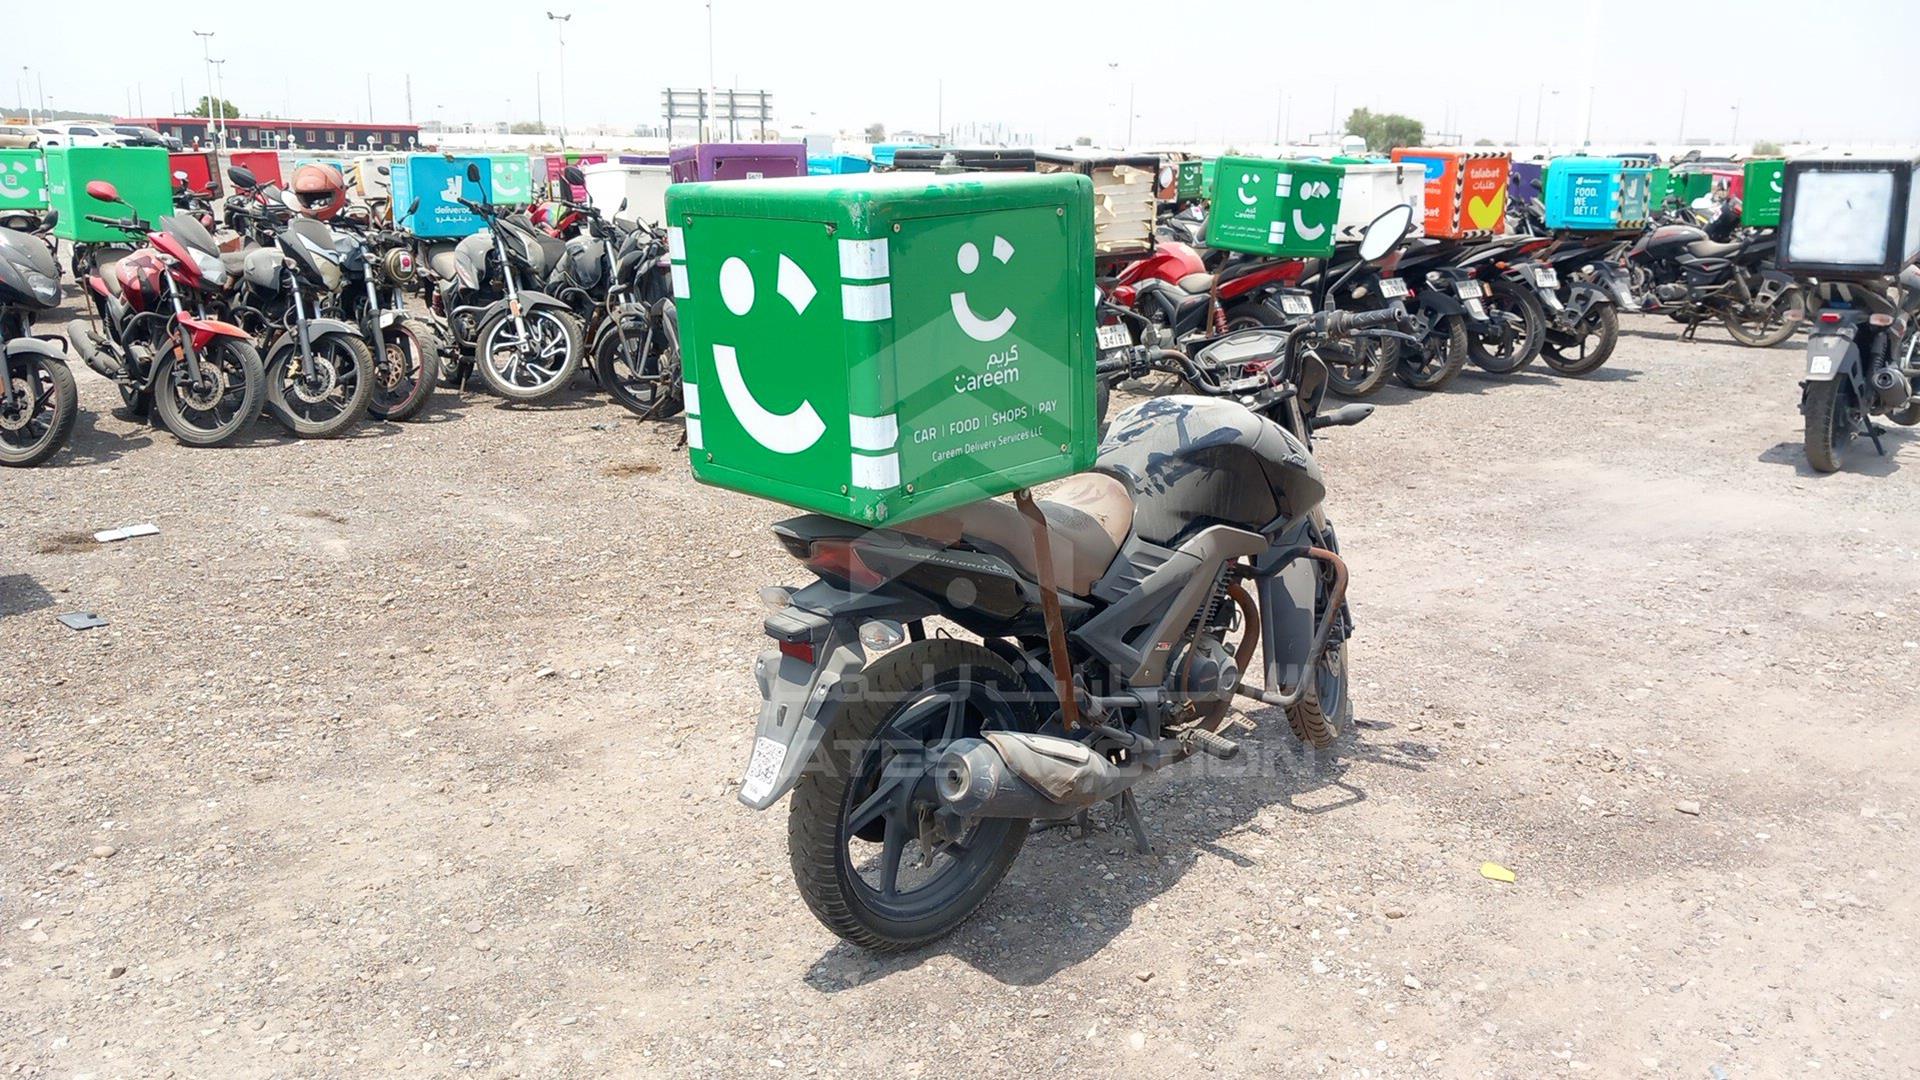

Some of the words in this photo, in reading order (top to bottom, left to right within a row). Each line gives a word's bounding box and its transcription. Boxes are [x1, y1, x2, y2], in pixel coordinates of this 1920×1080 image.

[1471, 168, 1500, 179] talabat
[1575, 187, 1598, 197] FOOD.
[1574, 197, 1586, 206] WE
[1573, 206, 1588, 215] GET
[1590, 206, 1599, 216] IT.
[987, 344, 1019, 370] كريم
[954, 367, 1019, 393] Careem
[914, 427, 937, 444] CAR
[949, 417, 980, 435] FOOD
[992, 406, 1028, 426] SHOPS
[1038, 400, 1058, 415] PAY
[932, 448, 963, 462] Careem
[964, 438, 997, 455] Delivery
[998, 431, 1030, 446] Services
[1031, 425, 1044, 438] LLC
